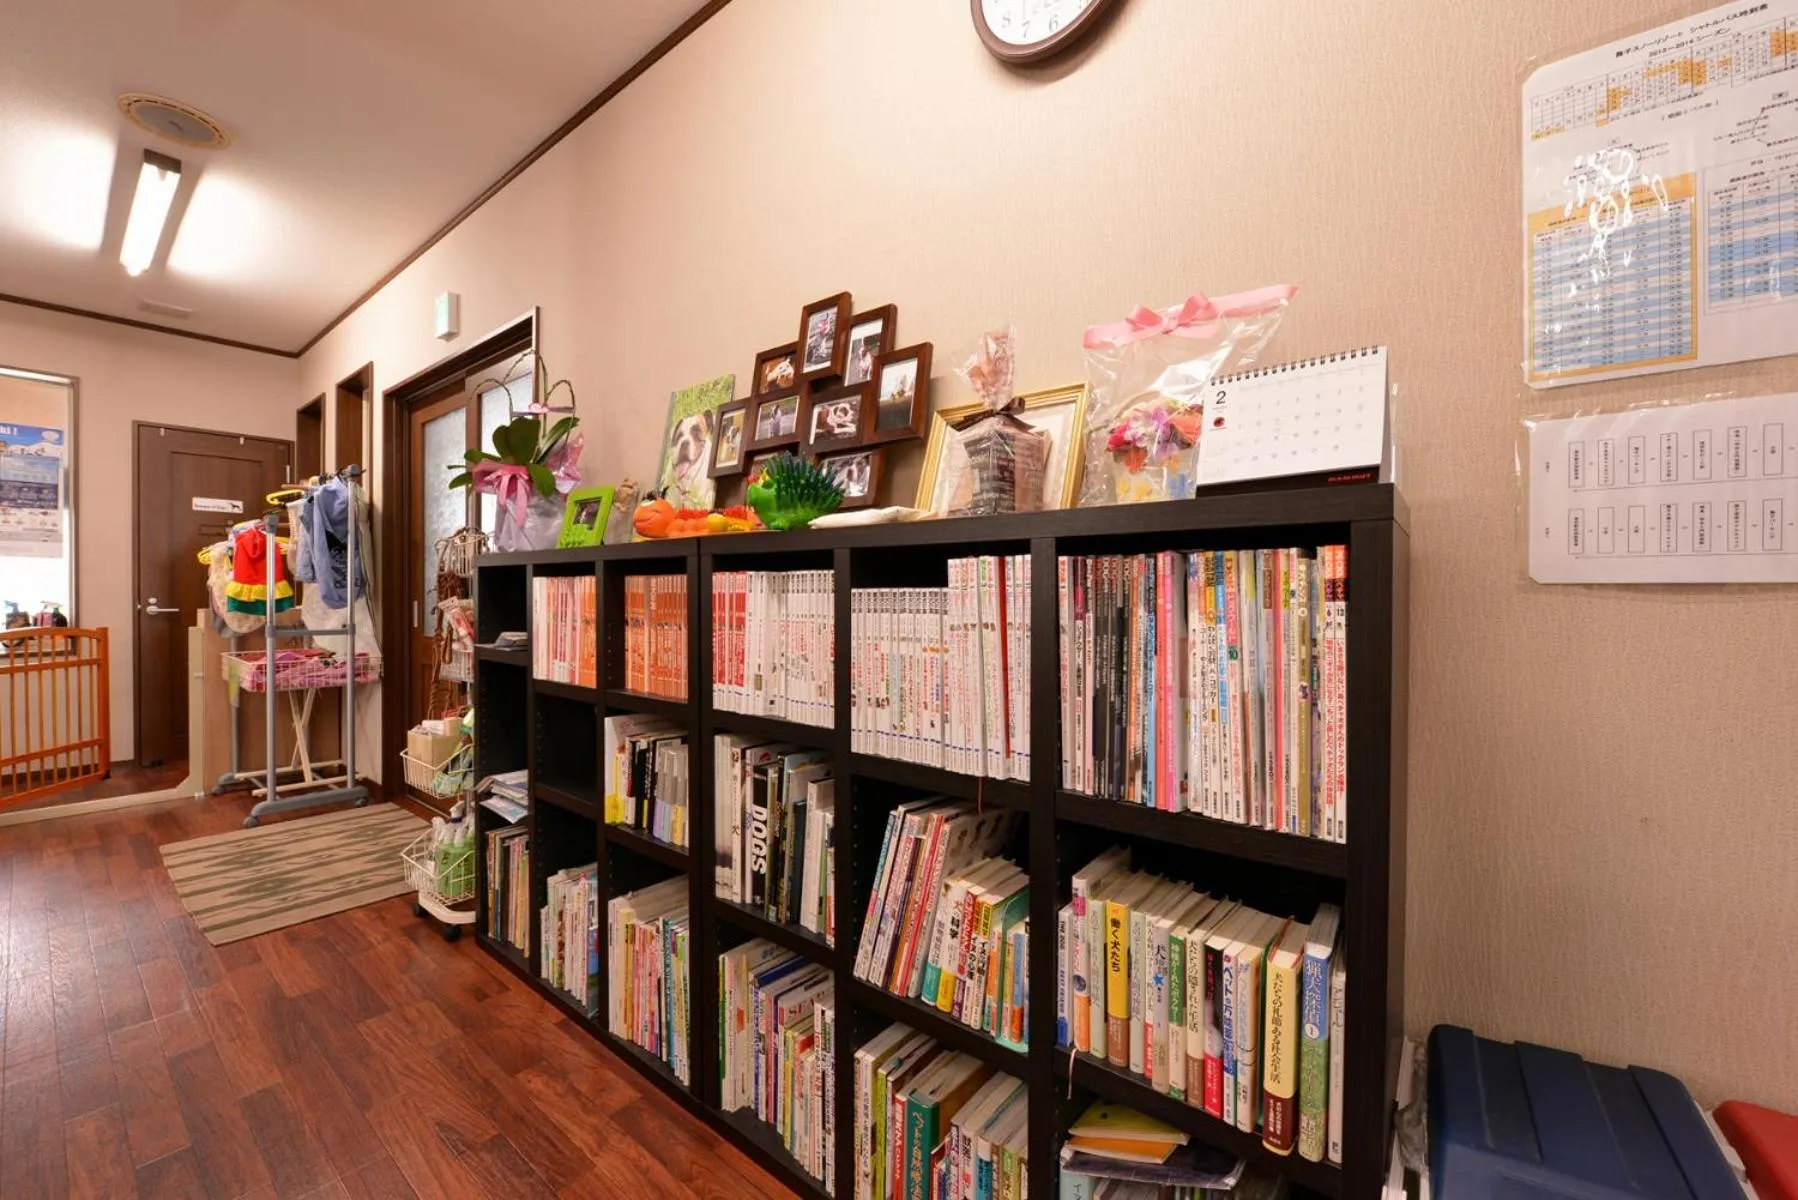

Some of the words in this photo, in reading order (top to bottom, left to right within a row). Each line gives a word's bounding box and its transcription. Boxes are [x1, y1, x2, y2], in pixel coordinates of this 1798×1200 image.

[1215, 390, 1227, 405] 2
[751, 805, 768, 875] DOGS
[1109, 917, 1122, 973] 働く犬たち
[1187, 939, 1199, 1033] 犬たちの隠された生活
